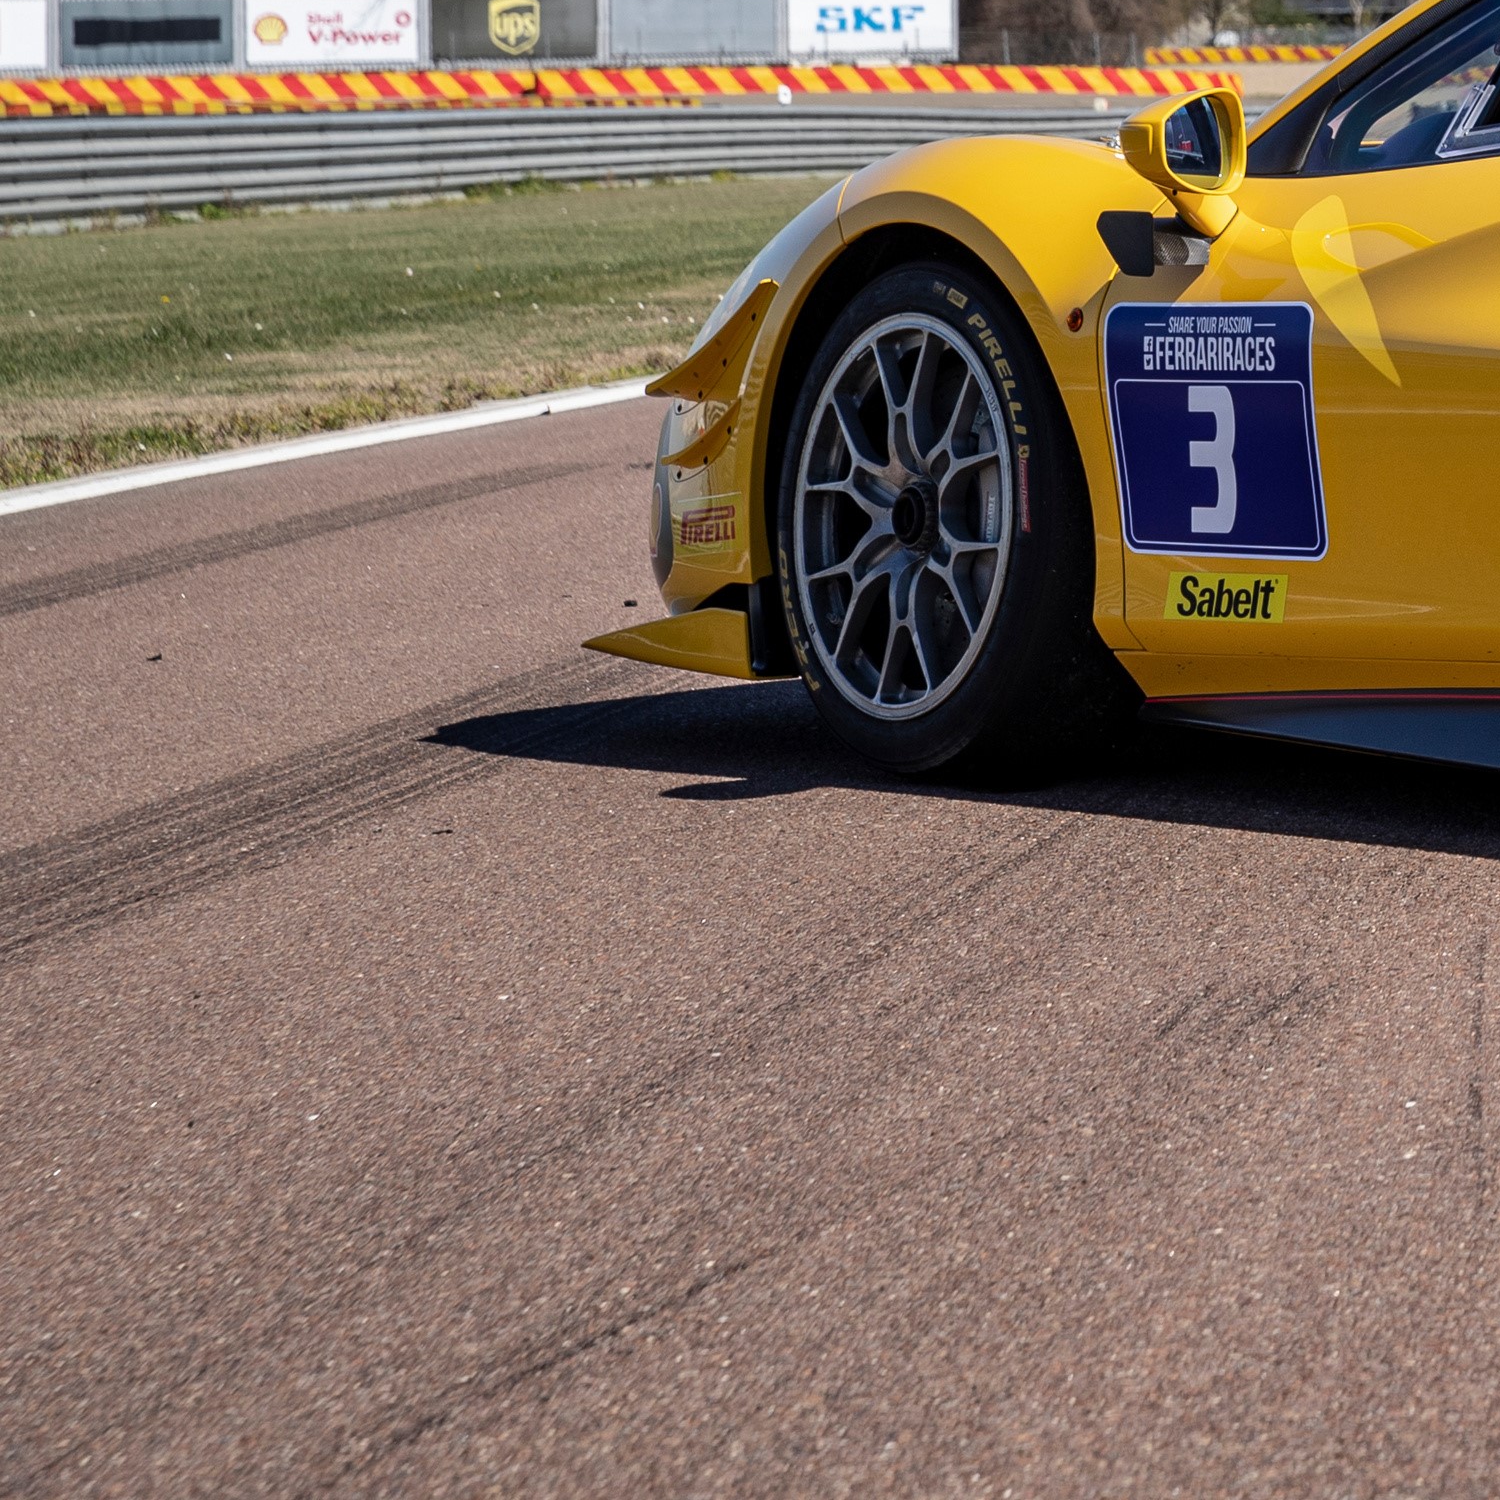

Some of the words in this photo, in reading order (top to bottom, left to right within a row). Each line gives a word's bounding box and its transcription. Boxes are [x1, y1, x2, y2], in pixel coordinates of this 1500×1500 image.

[307, 11, 343, 25] Shell
[494, 11, 537, 46] ups
[815, 5, 925, 33] SKF
[308, 28, 403, 45] V-Power
[1168, 316, 1195, 334] SHARE
[1196, 316, 1217, 334] YOUR
[1218, 316, 1252, 334] PASSION
[1155, 336, 1276, 372] FERRARIRACES
[967, 312, 1028, 436] PIRELLI
[1187, 385, 1238, 534] 3
[680, 504, 736, 546] PIRELLI
[1177, 575, 1275, 619] Sabelt
